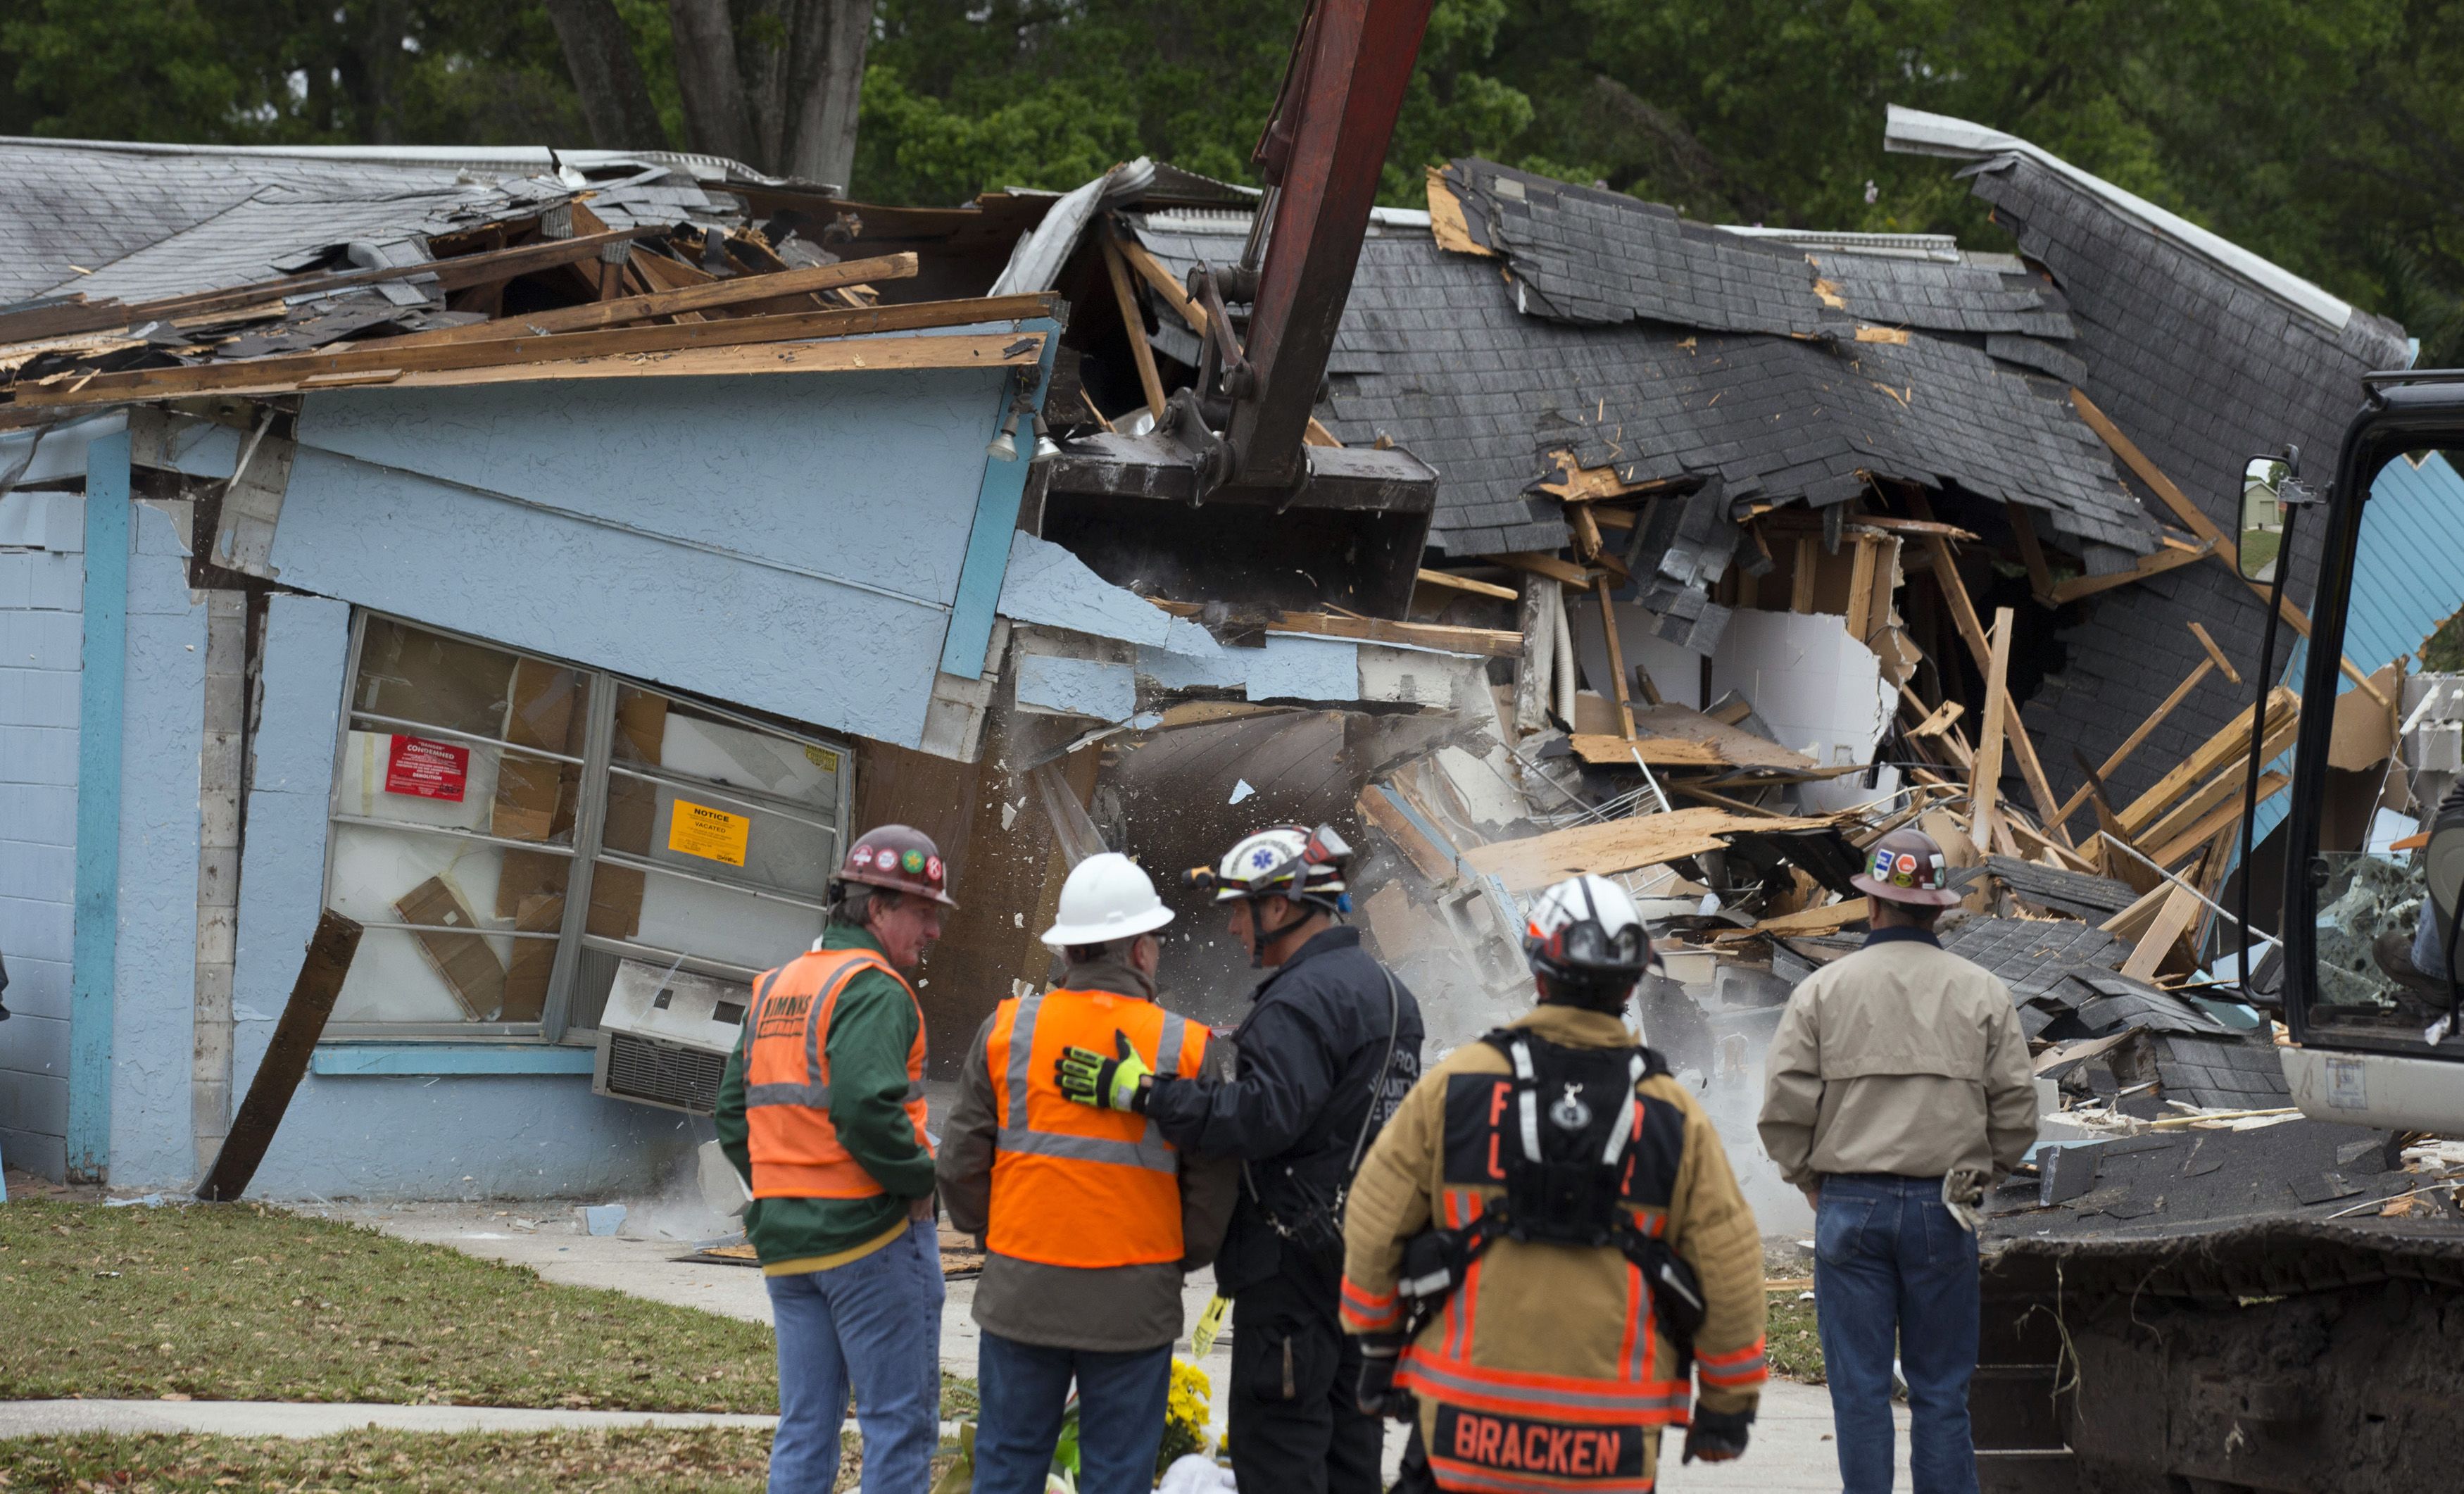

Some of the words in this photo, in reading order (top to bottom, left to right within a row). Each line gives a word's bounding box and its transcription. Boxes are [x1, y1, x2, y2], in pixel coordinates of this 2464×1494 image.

[407, 743, 455, 760] CONDEMNED
[412, 772, 443, 781] DEMOLITION
[694, 808, 730, 823] NOTICE
[695, 821, 727, 834] VACATED
[1454, 1411, 1621, 1476] BRACKEN
